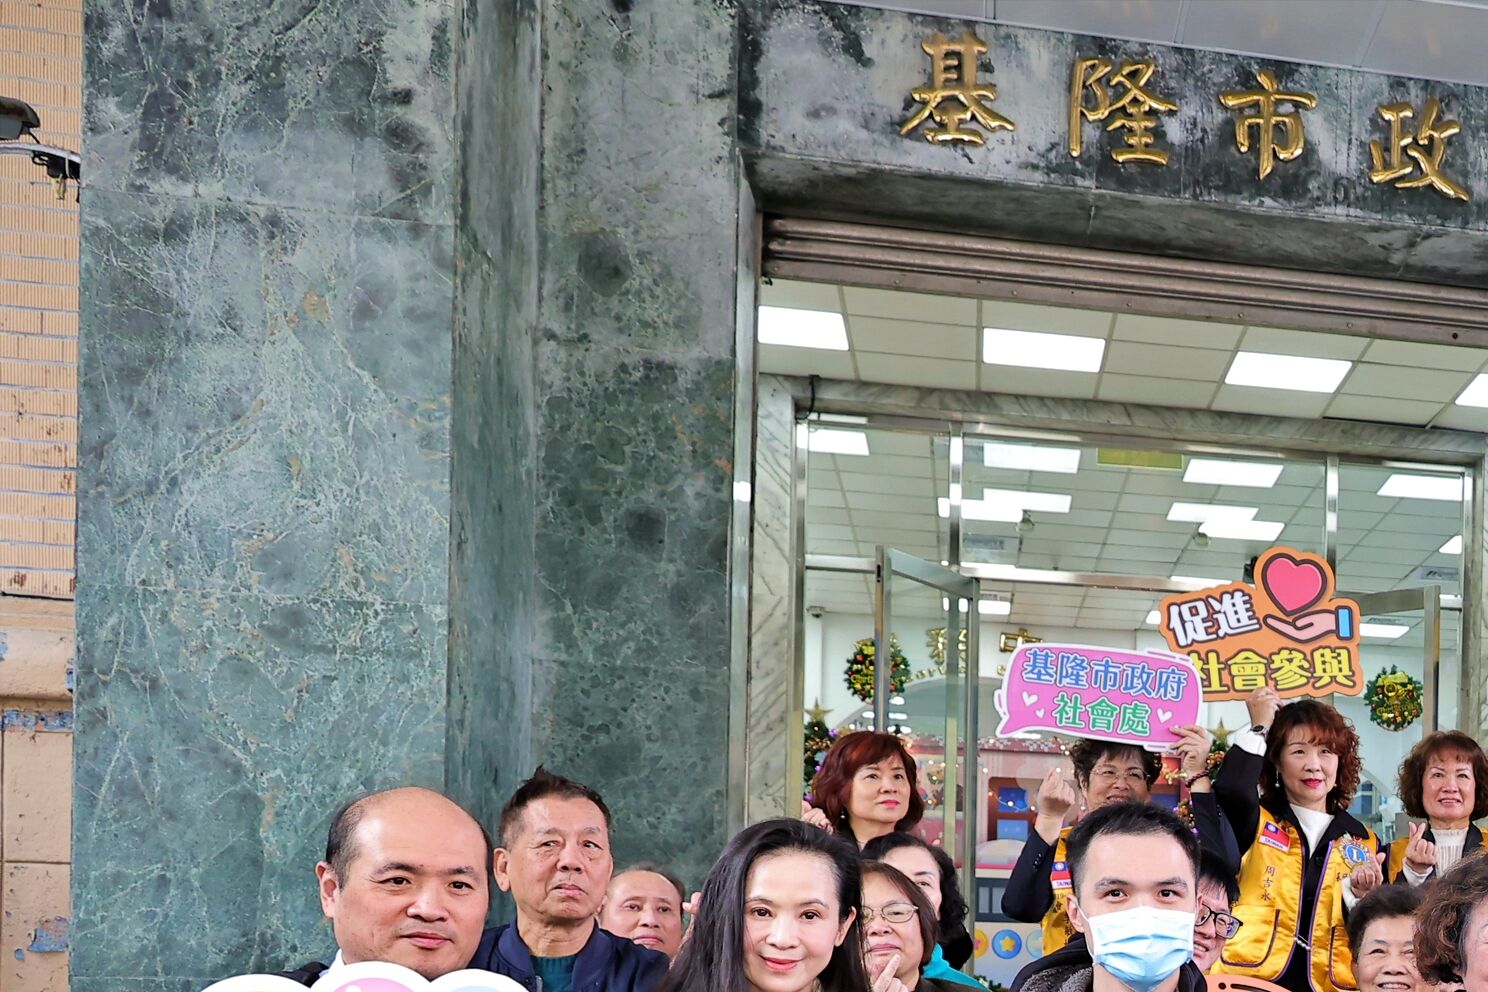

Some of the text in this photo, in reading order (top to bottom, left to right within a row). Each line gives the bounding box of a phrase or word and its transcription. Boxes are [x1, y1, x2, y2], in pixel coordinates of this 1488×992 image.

[1169, 589, 1261, 647] 促進
[1022, 648, 1188, 701] 基隆市政府
[1190, 646, 1356, 692] 社會參與
[1053, 693, 1154, 737] 社會處
